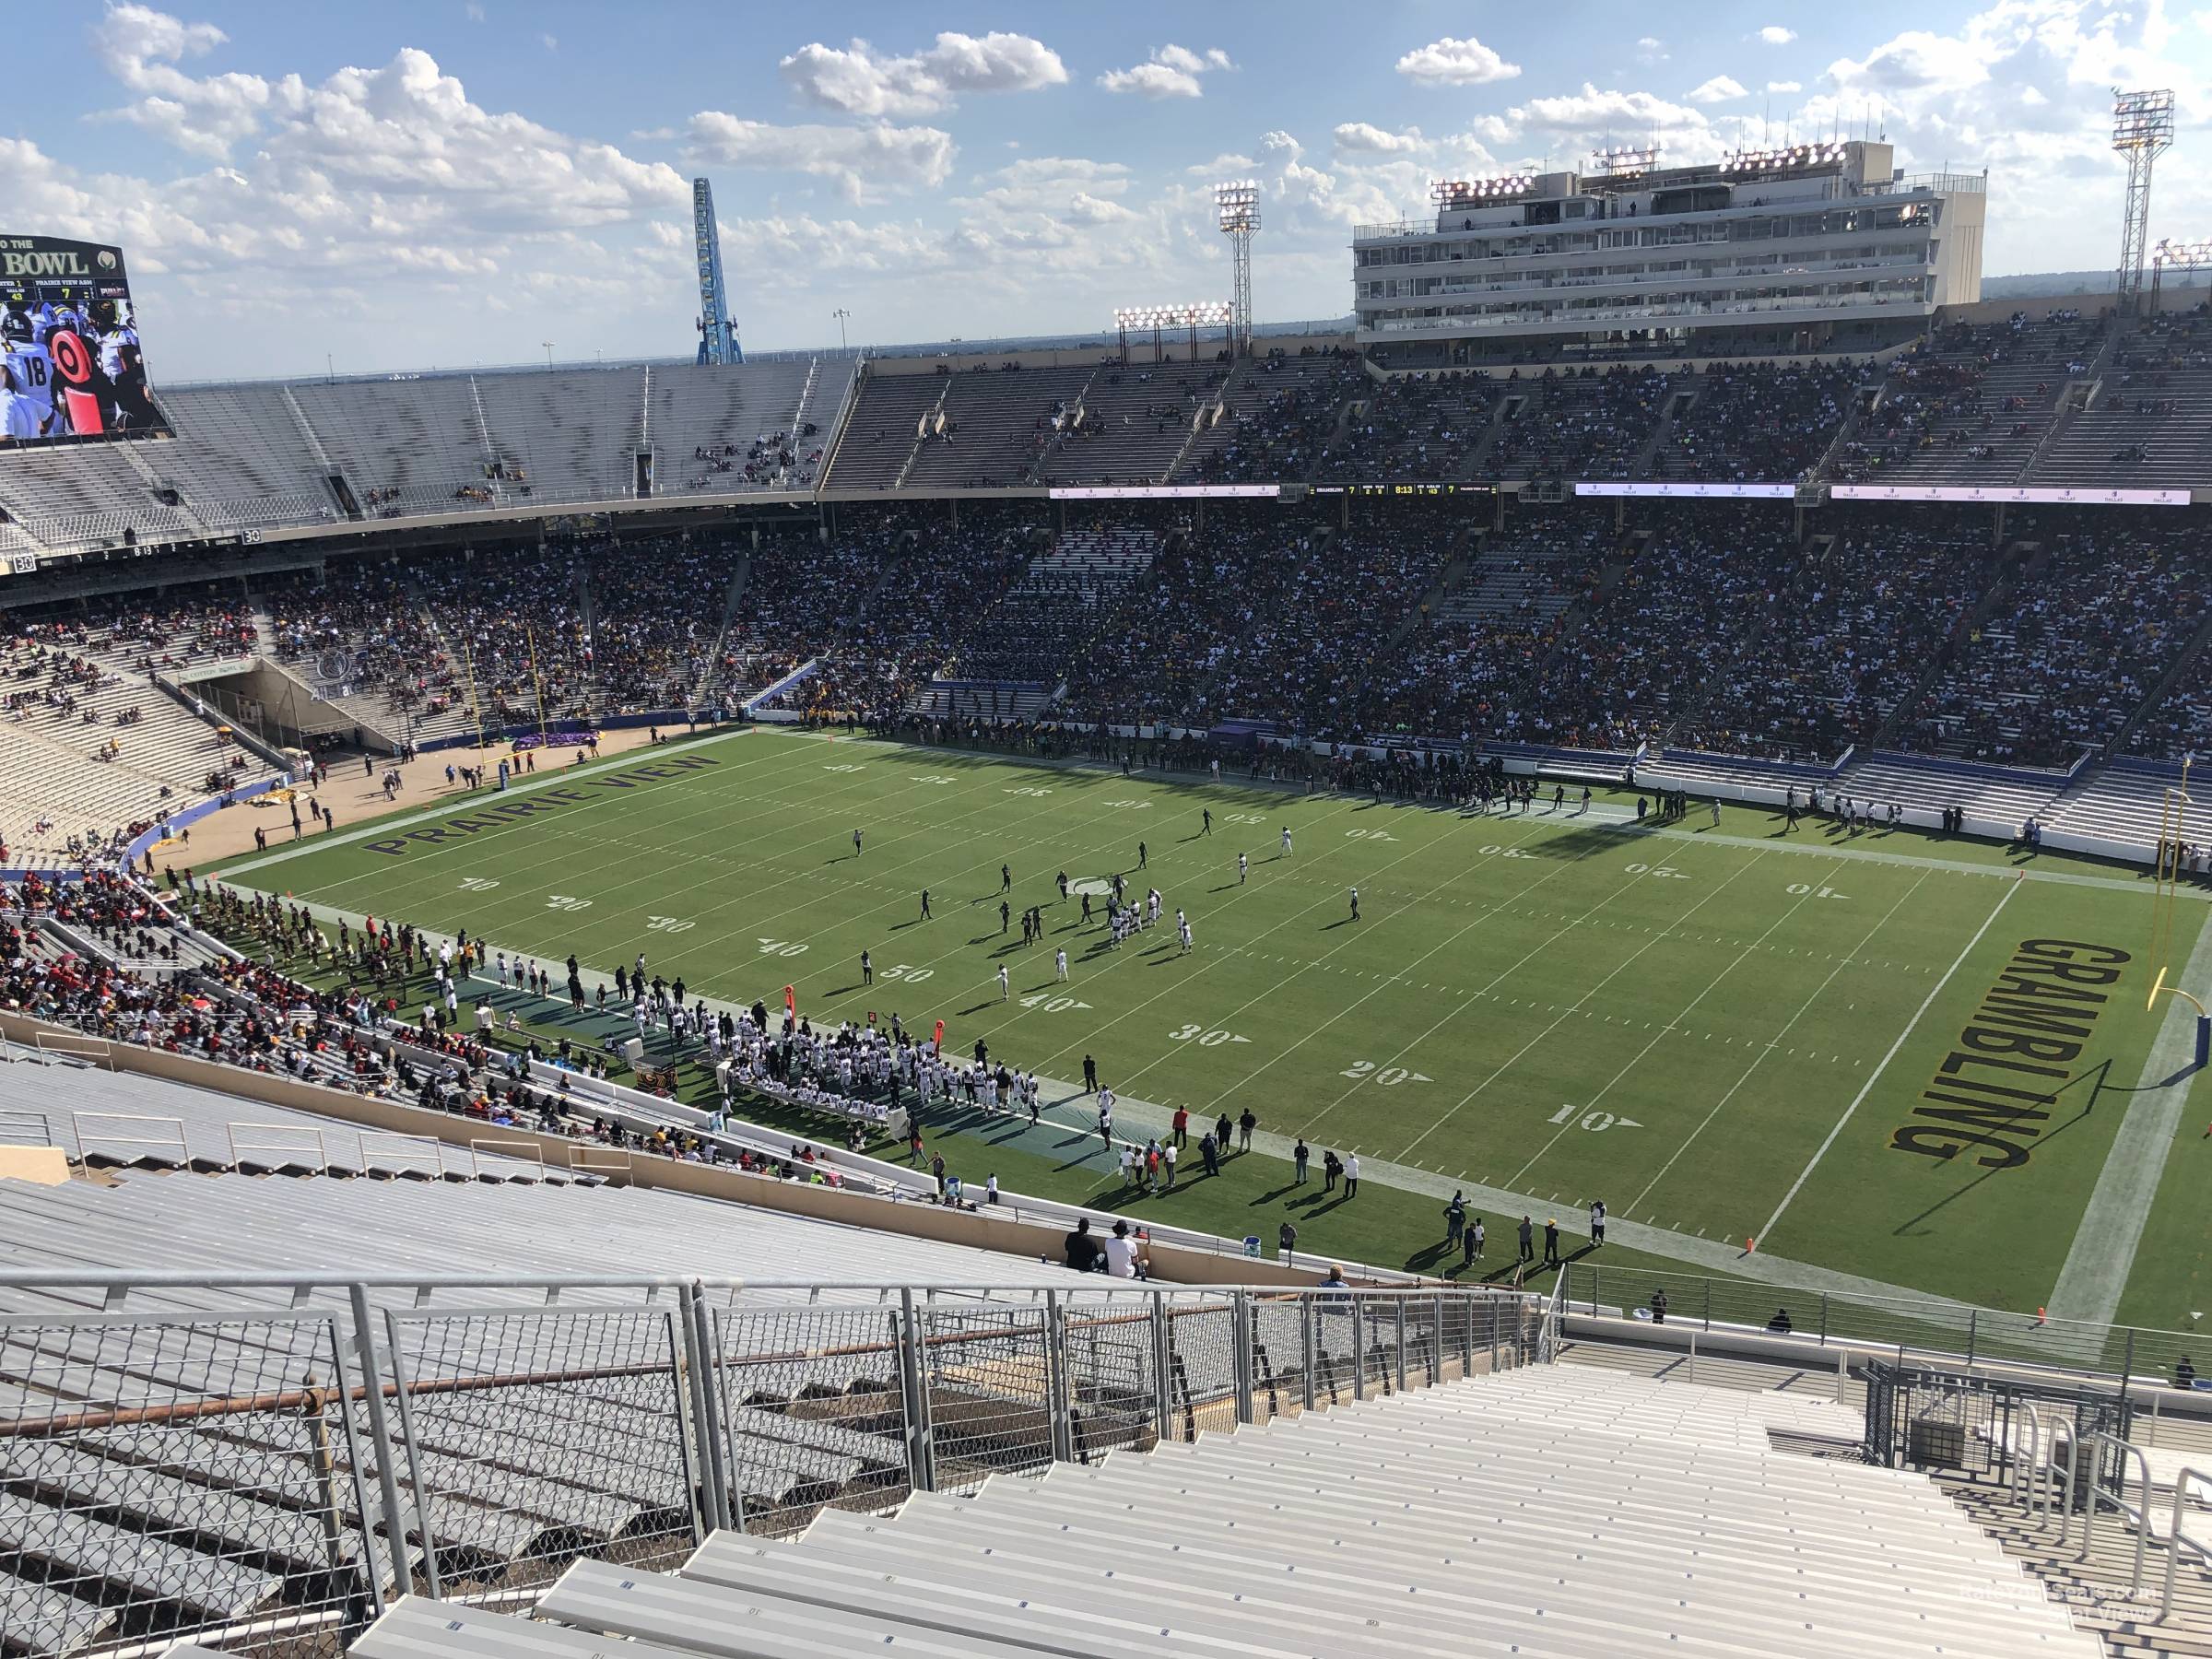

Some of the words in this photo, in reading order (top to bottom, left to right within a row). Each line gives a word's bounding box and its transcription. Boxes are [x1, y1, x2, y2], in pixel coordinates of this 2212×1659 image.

[10, 240, 33, 249] THE
[2, 252, 89, 276] BOWL
[62, 288, 70, 299] 7
[24, 356, 47, 386] 18
[1348, 486, 1355, 494] 7
[1395, 486, 1413, 494] 8:13
[1448, 486, 1454, 494] 7
[243, 530, 260, 543] 30
[134, 546, 152, 557] 8:13
[17, 556, 33, 571] 30
[189, 669, 217, 680] COTTON
[219, 665, 239, 675] BOWL
[310, 681, 363, 701] Allstate
[832, 764, 867, 774] 10
[919, 775, 959, 784] 20
[1013, 787, 1053, 797] 30
[362, 786, 605, 856] PRAIRIE
[586, 754, 722, 789] VIEW
[1113, 799, 1154, 809] 40
[1222, 813, 1267, 826] 50
[1345, 829, 1388, 840] 40
[1477, 845, 1526, 859] 30
[1624, 863, 1679, 877] 20
[457, 878, 500, 891] 10
[1785, 883, 1837, 899] 10
[546, 897, 593, 912] 20
[647, 917, 696, 933] 30
[757, 941, 809, 957] 40
[880, 965, 934, 982] 50
[1018, 994, 1075, 1013] 40
[1169, 1024, 1230, 1046] 30
[1889, 938, 2132, 1169] GRAMBLING
[1339, 1061, 1408, 1086] 20
[1547, 1104, 1616, 1133] 10
